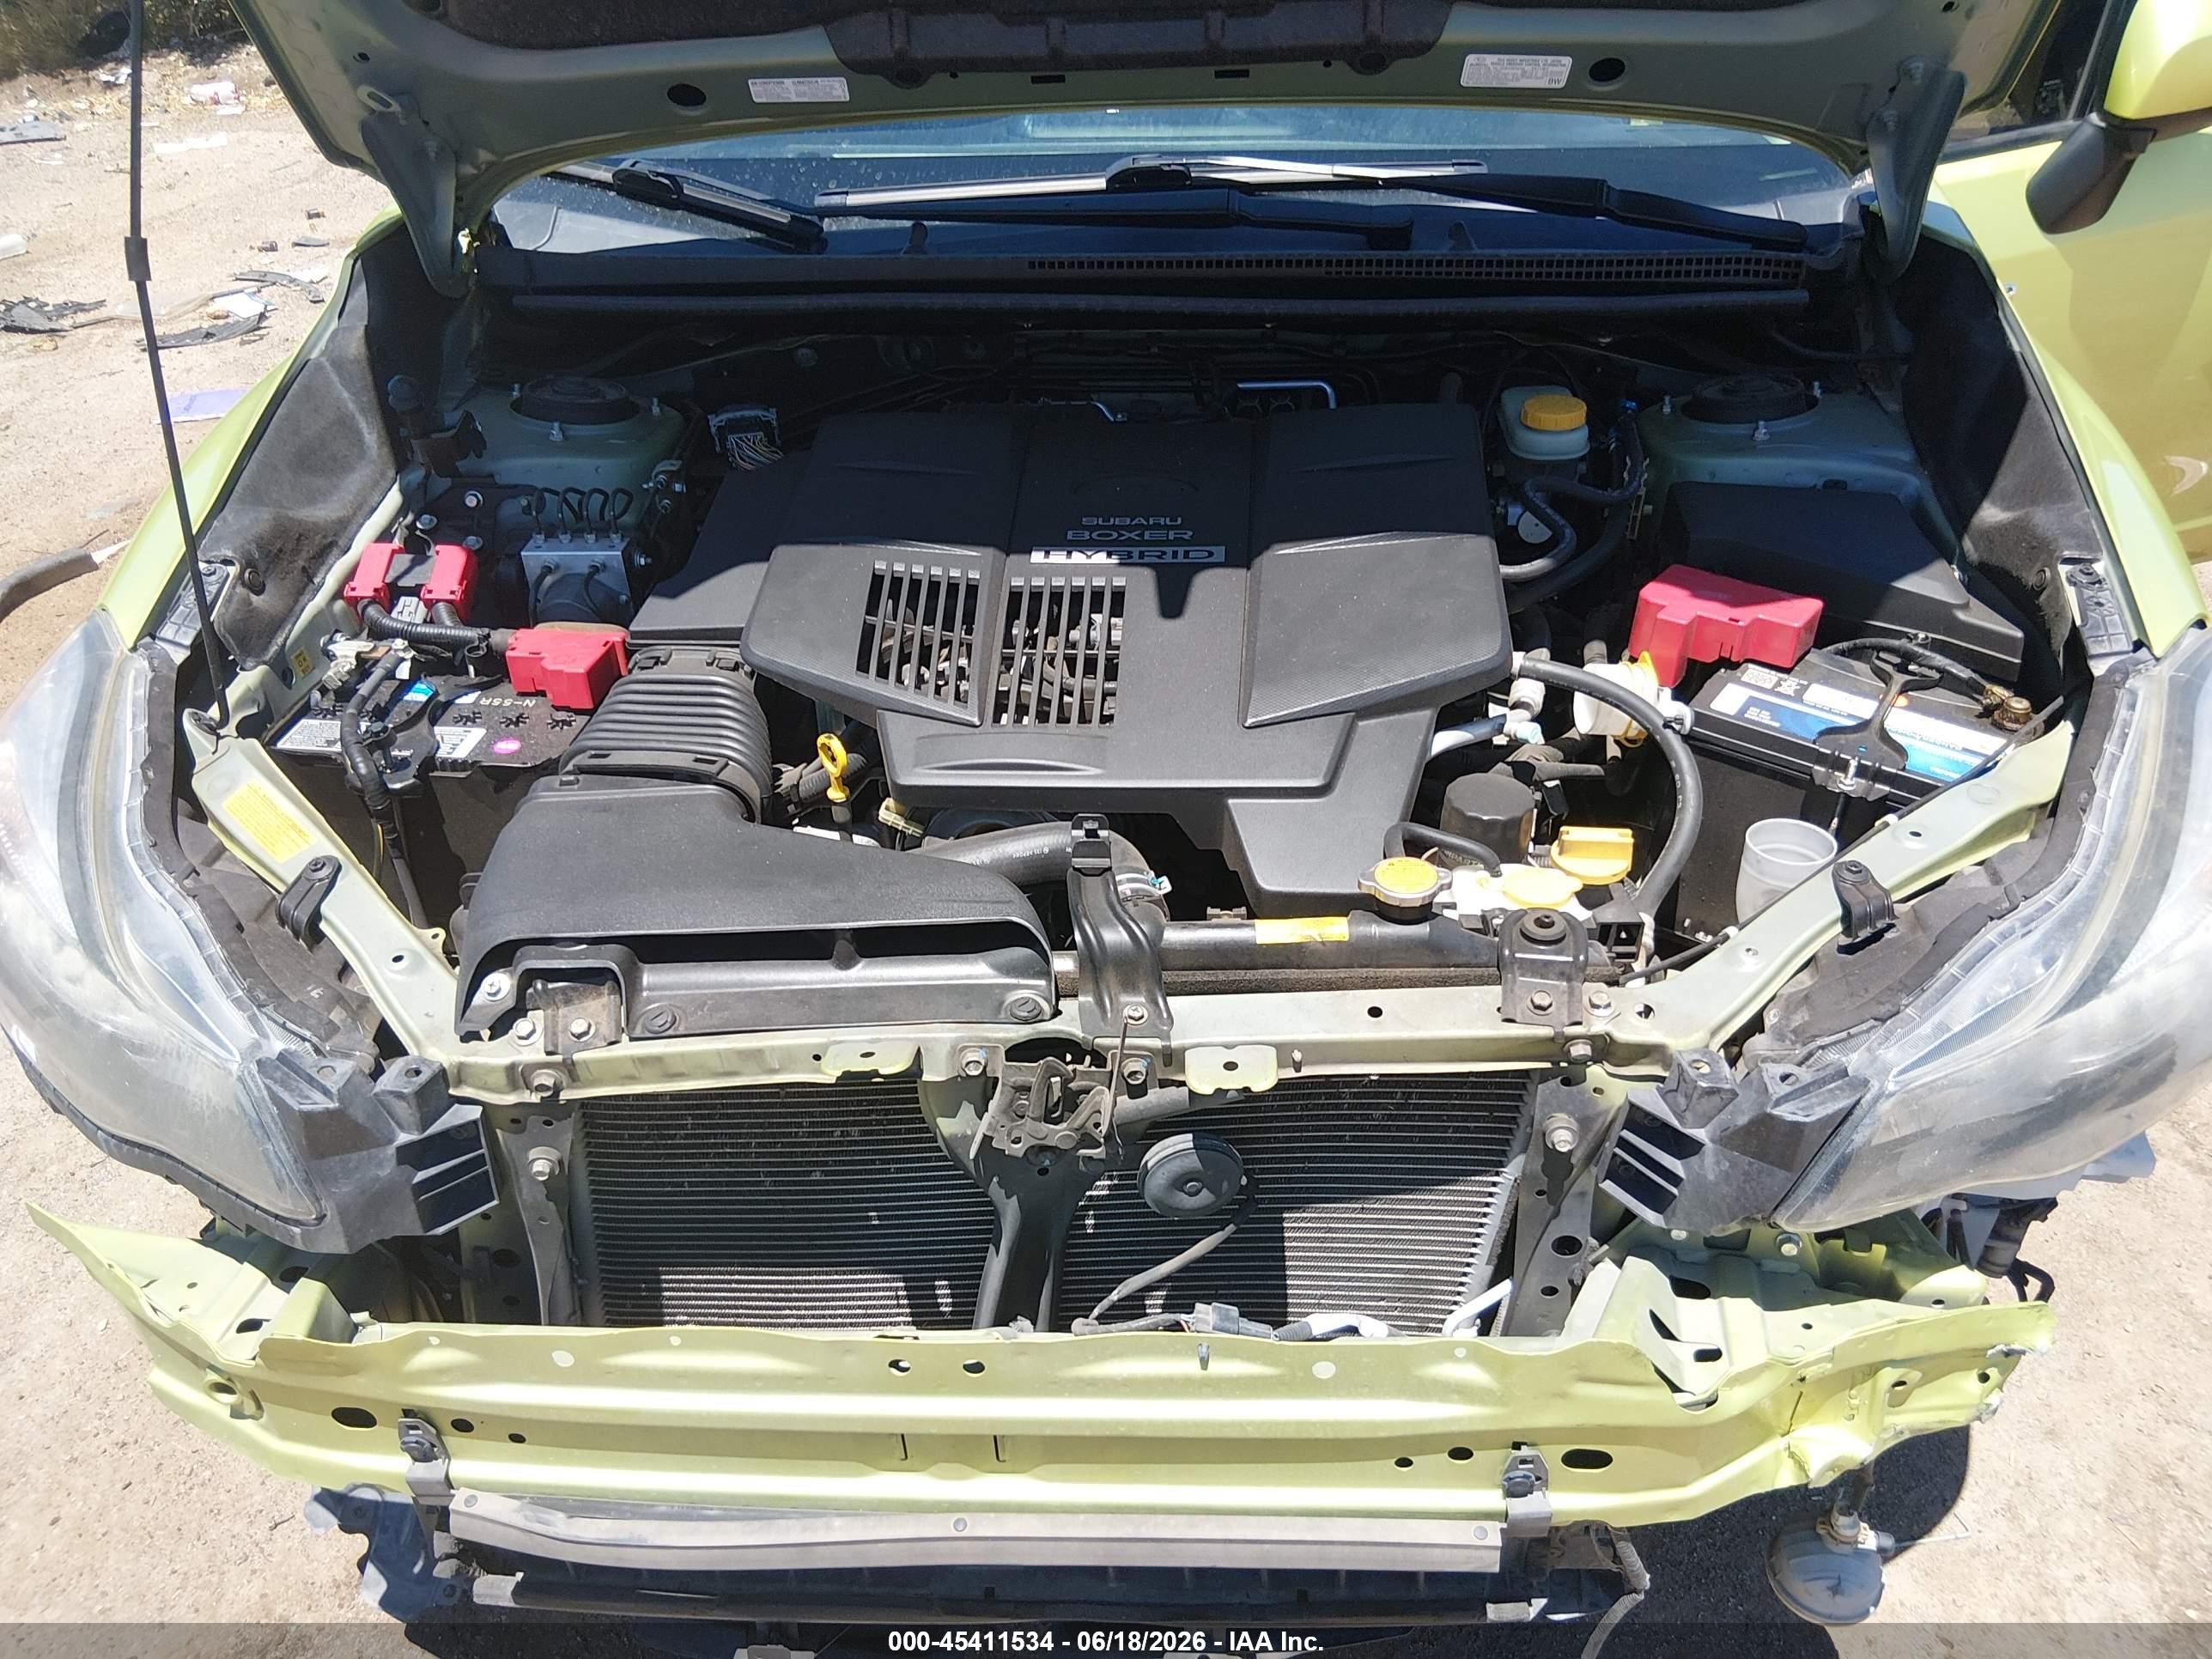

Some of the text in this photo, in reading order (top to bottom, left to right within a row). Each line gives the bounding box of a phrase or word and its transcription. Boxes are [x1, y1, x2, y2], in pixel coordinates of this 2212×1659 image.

[1081, 516, 1182, 526] SUBARU
[1066, 529, 1194, 541] BOXER
[1042, 549, 1217, 562] HYBRID
[479, 696, 537, 708] N-55R
